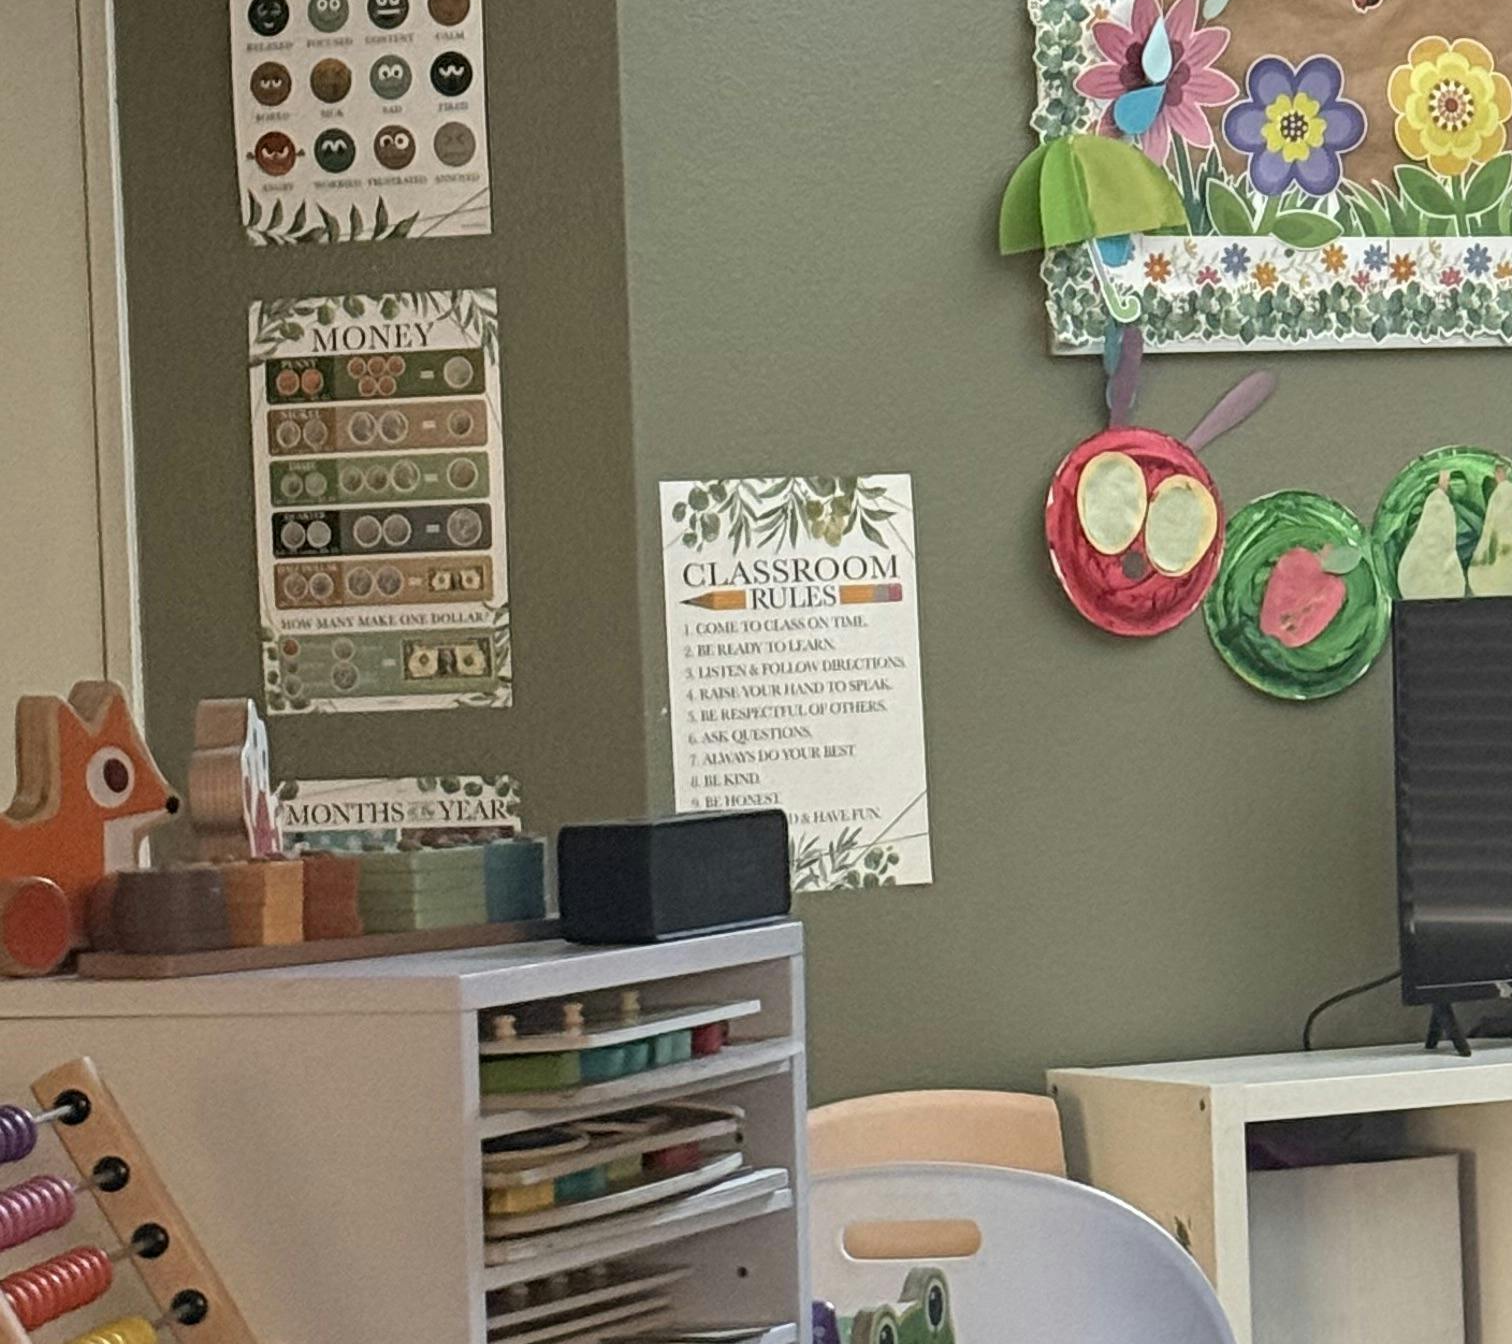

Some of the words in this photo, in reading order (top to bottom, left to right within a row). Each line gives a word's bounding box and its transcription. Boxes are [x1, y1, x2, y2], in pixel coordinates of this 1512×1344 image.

[312, 322, 434, 353] MONEY
[682, 554, 900, 588] CLASSROOM
[750, 584, 837, 610] RULES
[281, 618, 312, 630] HOW
[316, 616, 354, 628] MANY
[358, 614, 394, 627] MAKE
[400, 614, 427, 625] ONE
[431, 610, 490, 624] DOLLAR?
[696, 621, 738, 636] COME
[741, 619, 762, 633] TO
[764, 617, 806, 632] CLASS
[807, 617, 829, 629] ON
[697, 643, 716, 657] BE
[717, 641, 763, 656] READY
[767, 640, 787, 653] TO
[698, 664, 747, 679] LISTEN
[749, 663, 759, 676] &
[762, 660, 818, 676] FOLLOW
[700, 686, 740, 702] RAISE
[742, 683, 781, 698] YOUR
[784, 682, 825, 696] HAND
[828, 680, 848, 693] TO
[701, 709, 718, 723] BE
[721, 704, 808, 722] RESPECTFUL
[808, 702, 828, 716] OF
[702, 730, 731, 744] ASK
[703, 750, 757, 765] ALWAYS
[758, 749, 780, 763] DO
[783, 747, 821, 762] YOUR
[704, 773, 720, 787] BE
[705, 796, 723, 808] BE
[287, 801, 405, 826] MONTHS
[436, 799, 509, 821] YEAR
[801, 811, 811, 824] &
[813, 808, 851, 823] HAVE
